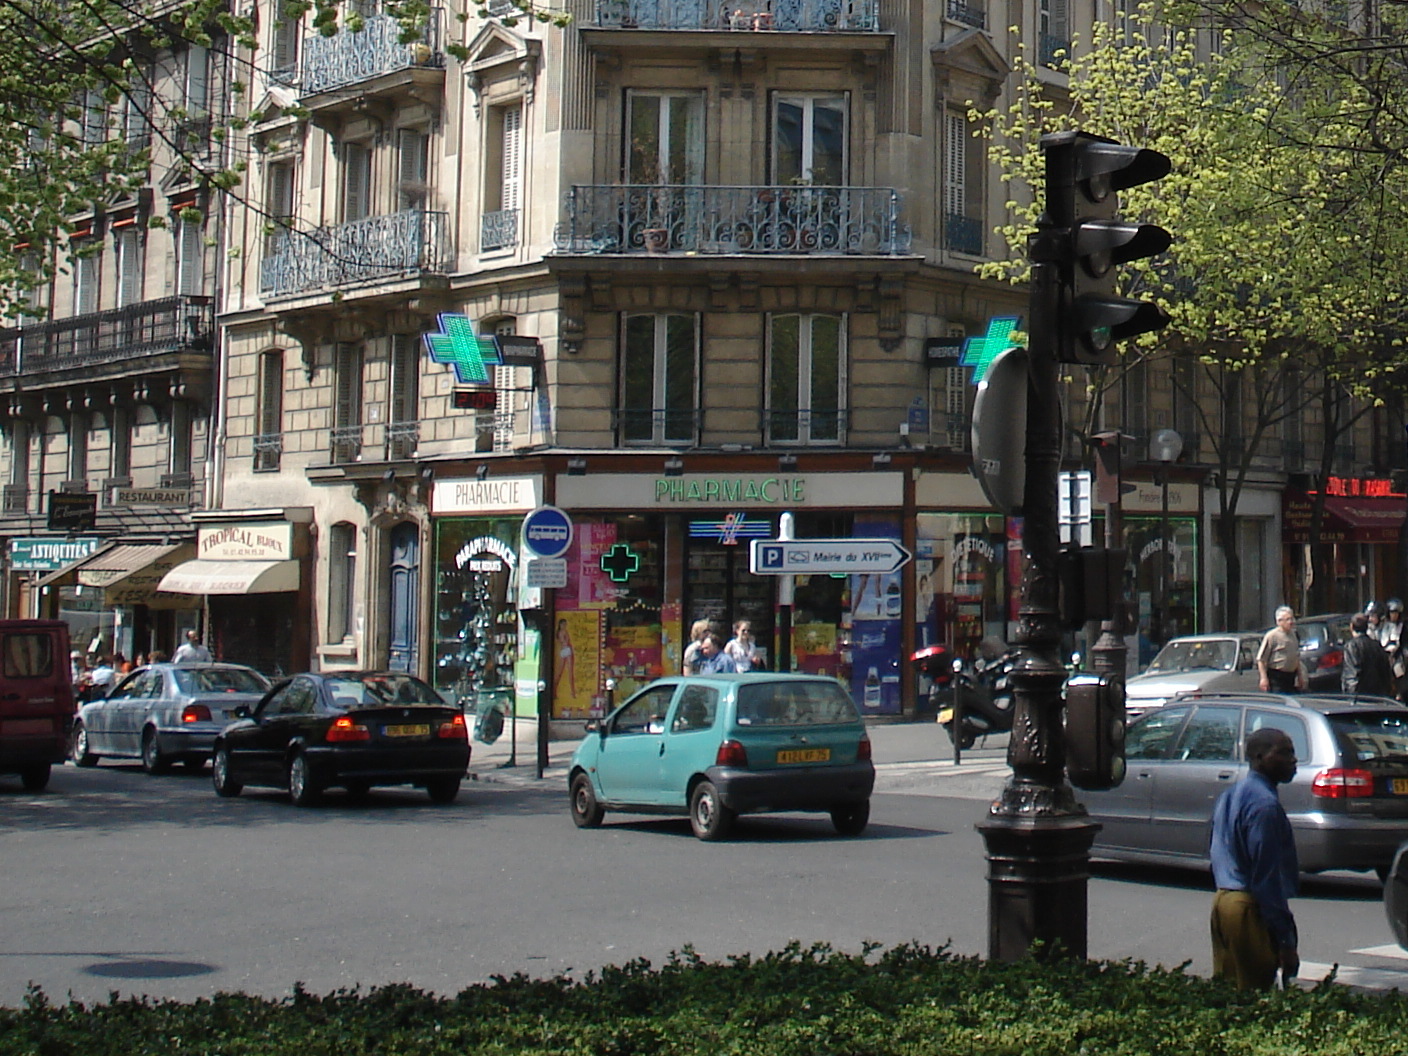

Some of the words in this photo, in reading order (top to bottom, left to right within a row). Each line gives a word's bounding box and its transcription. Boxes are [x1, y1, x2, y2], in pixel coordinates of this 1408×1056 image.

[118, 492, 187, 504] RESTAURANT
[455, 482, 520, 506] PHARMACIE
[655, 477, 806, 503] PHARMACIE
[31, 540, 88, 561] ANTIQUITÉS
[201, 526, 254, 553] TROPICAL
[257, 534, 284, 553] BIJOUX
[767, 549, 779, 565] P
[813, 552, 842, 562] Mairie
[845, 552, 858, 562] du
